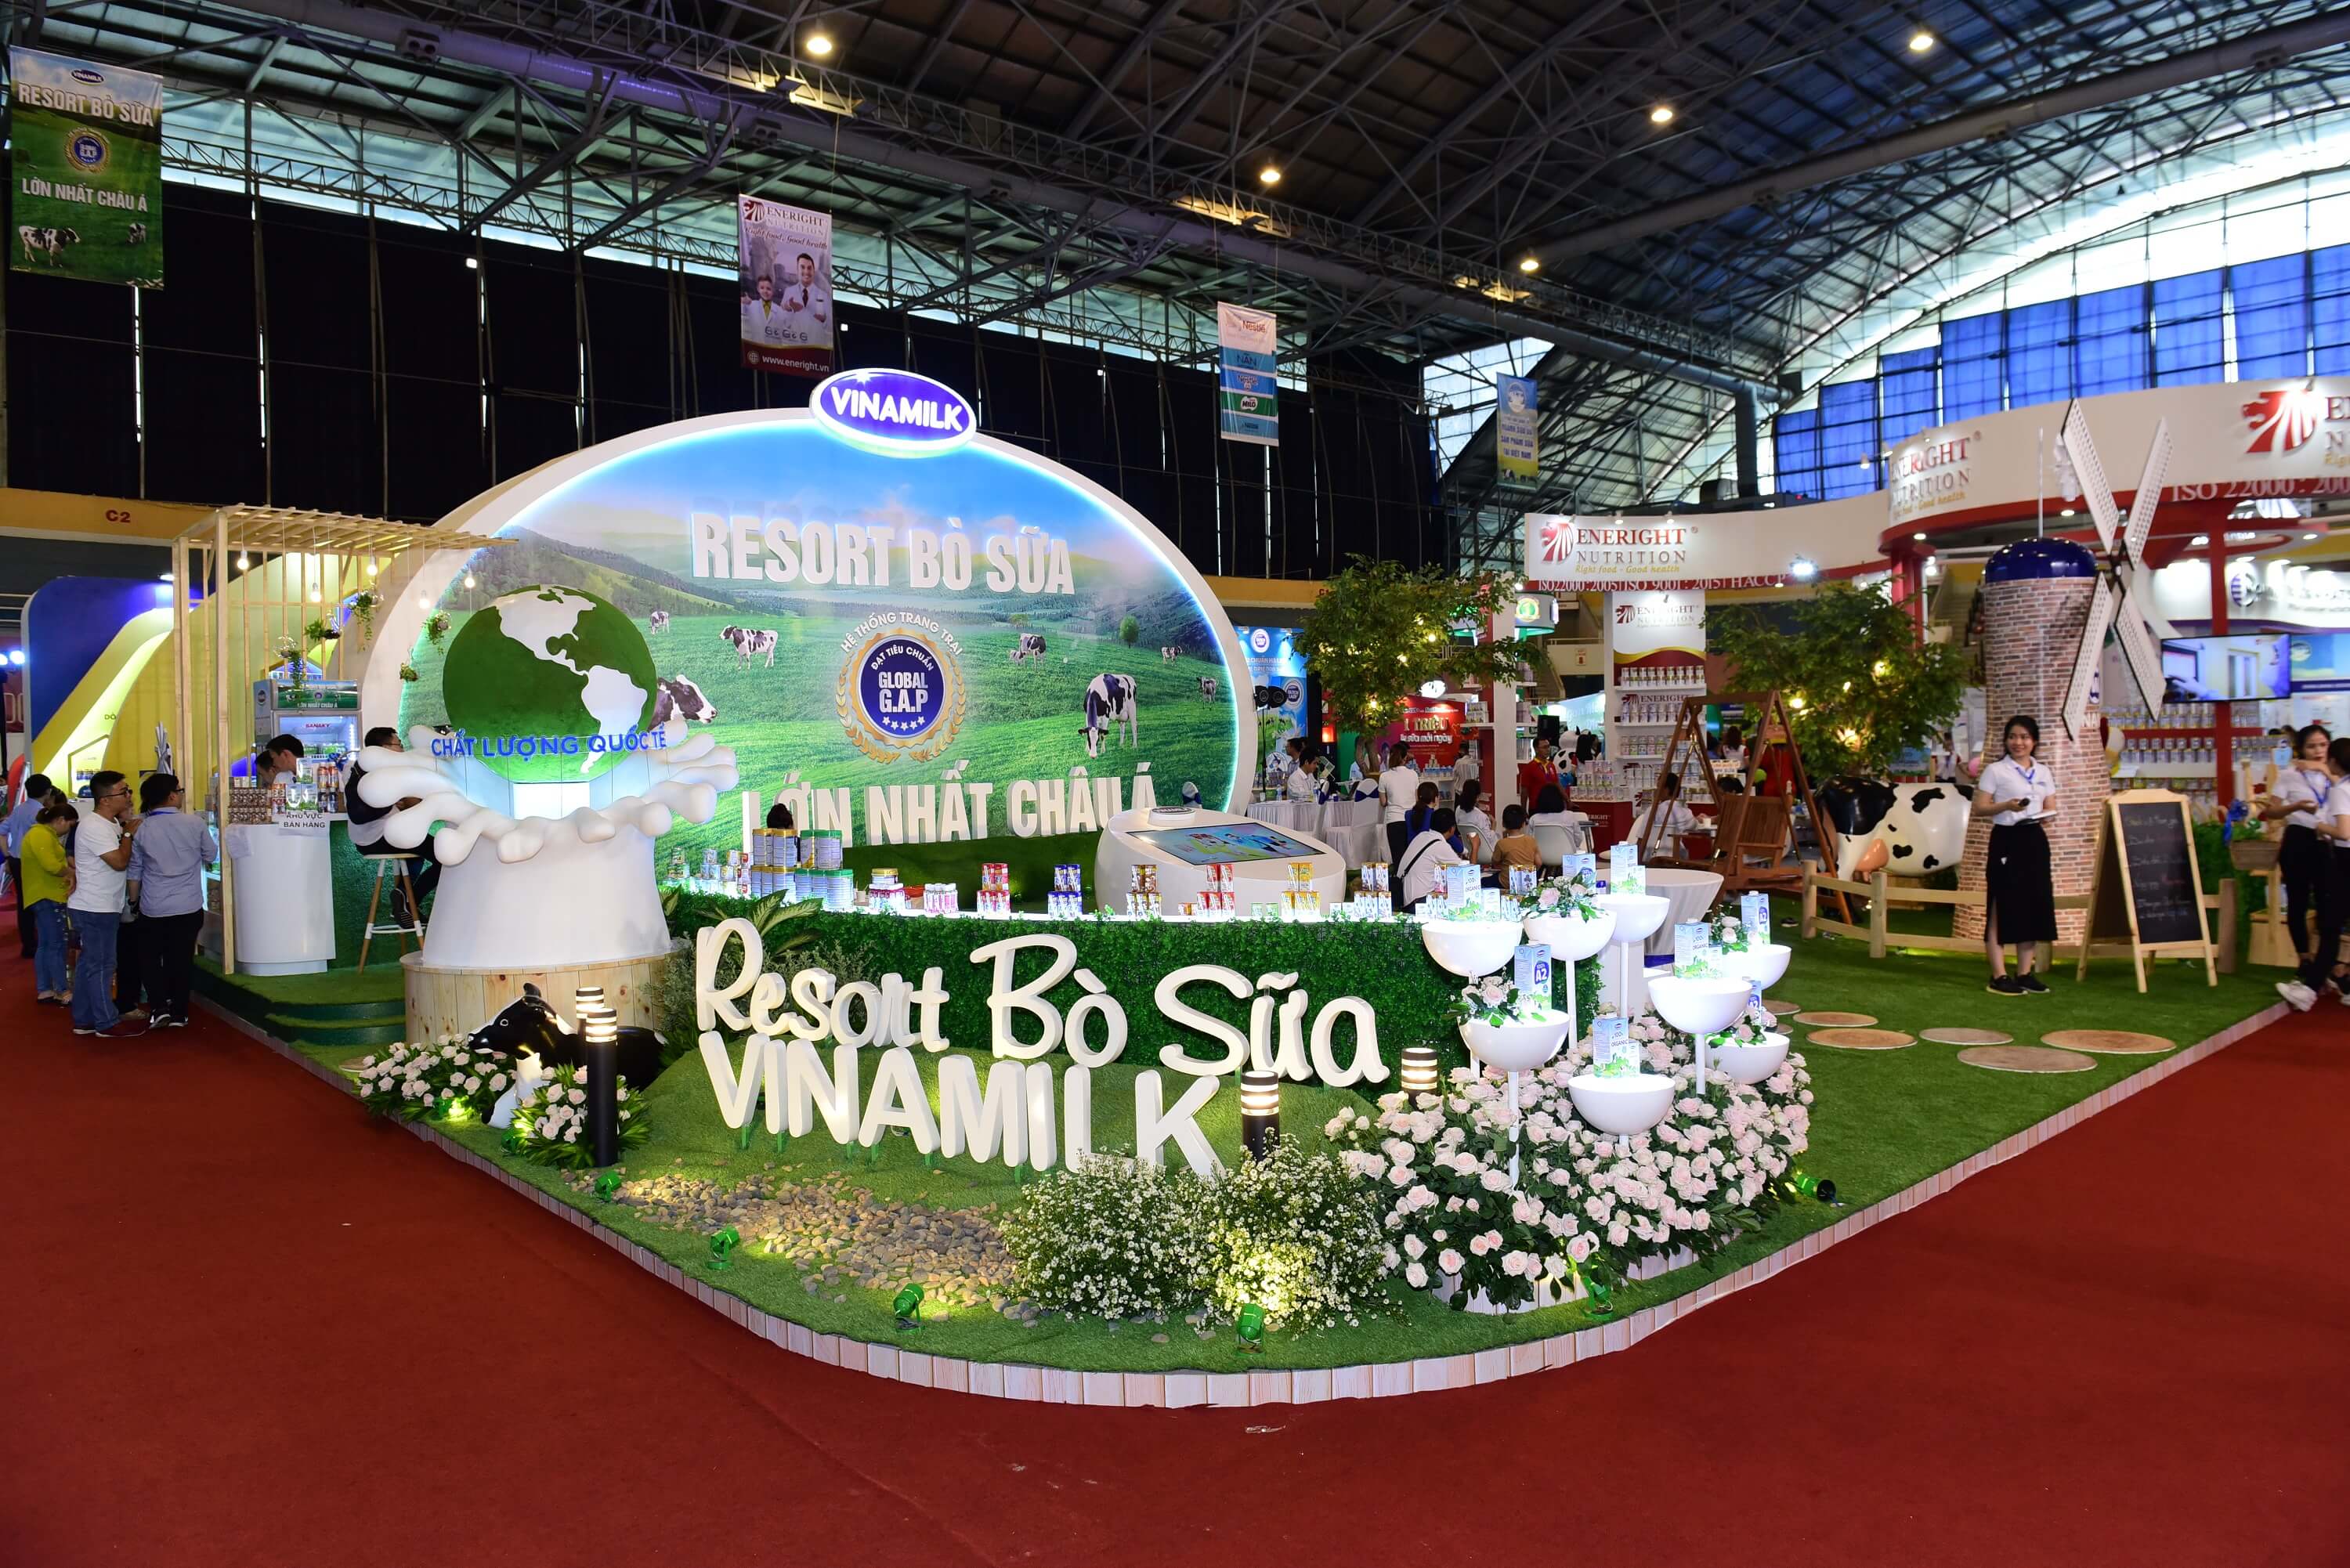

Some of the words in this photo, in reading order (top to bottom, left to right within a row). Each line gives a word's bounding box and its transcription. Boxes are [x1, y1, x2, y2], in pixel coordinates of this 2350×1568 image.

[18, 82, 88, 115] RESORT
[22, 176, 51, 197] LỚN
[55, 182, 94, 204] NHẤT
[97, 189, 136, 210] CHÂU
[137, 194, 148, 213] Á
[766, 206, 824, 227] ENERIGHT
[762, 355, 830, 373] www.eneright.vn
[830, 386, 963, 432] VINAMILK
[2172, 482, 2218, 502] ISO
[2223, 478, 2295, 498] 22000
[105, 510, 131, 523] C2
[1577, 527, 1687, 546] ENERIGHT
[691, 513, 895, 587] RESORT
[909, 517, 973, 591] BÒ
[985, 525, 1076, 595] SỮA
[1576, 550, 1687, 565] NUTRITION
[1575, 564, 1596, 574] Right
[1598, 564, 1617, 574] food
[1625, 564, 1648, 574] Good
[1650, 564, 1680, 574] health
[1692, 579, 1722, 590] 2015
[1730, 574, 1786, 589] HACCP
[841, 632, 859, 652] HỆ
[854, 611, 897, 638] THỐNG
[900, 612, 941, 634] TRANG
[940, 629, 964, 656] TRẠI
[870, 652, 887, 671] ĐẠT
[886, 644, 904, 658] TIÊU
[878, 671, 928, 689] GLOBAL
[879, 688, 929, 714] G.A.P
[431, 728, 476, 757] CHẤT
[483, 734, 579, 761] LƯỢNG
[588, 724, 649, 752] QUỐC
[651, 721, 667, 749] TẾ
[865, 761, 993, 845] NHẤT
[1008, 765, 1123, 839] CHÂU
[1132, 761, 1158, 808] Á
[1535, 968, 1548, 982] A2
[696, 917, 950, 1054] Resort
[970, 932, 1129, 1069] Bò
[1154, 963, 1390, 1089] Sữa
[1611, 1039, 1629, 1047] ORGANIC
[697, 1028, 1228, 1180] VINAMILK
